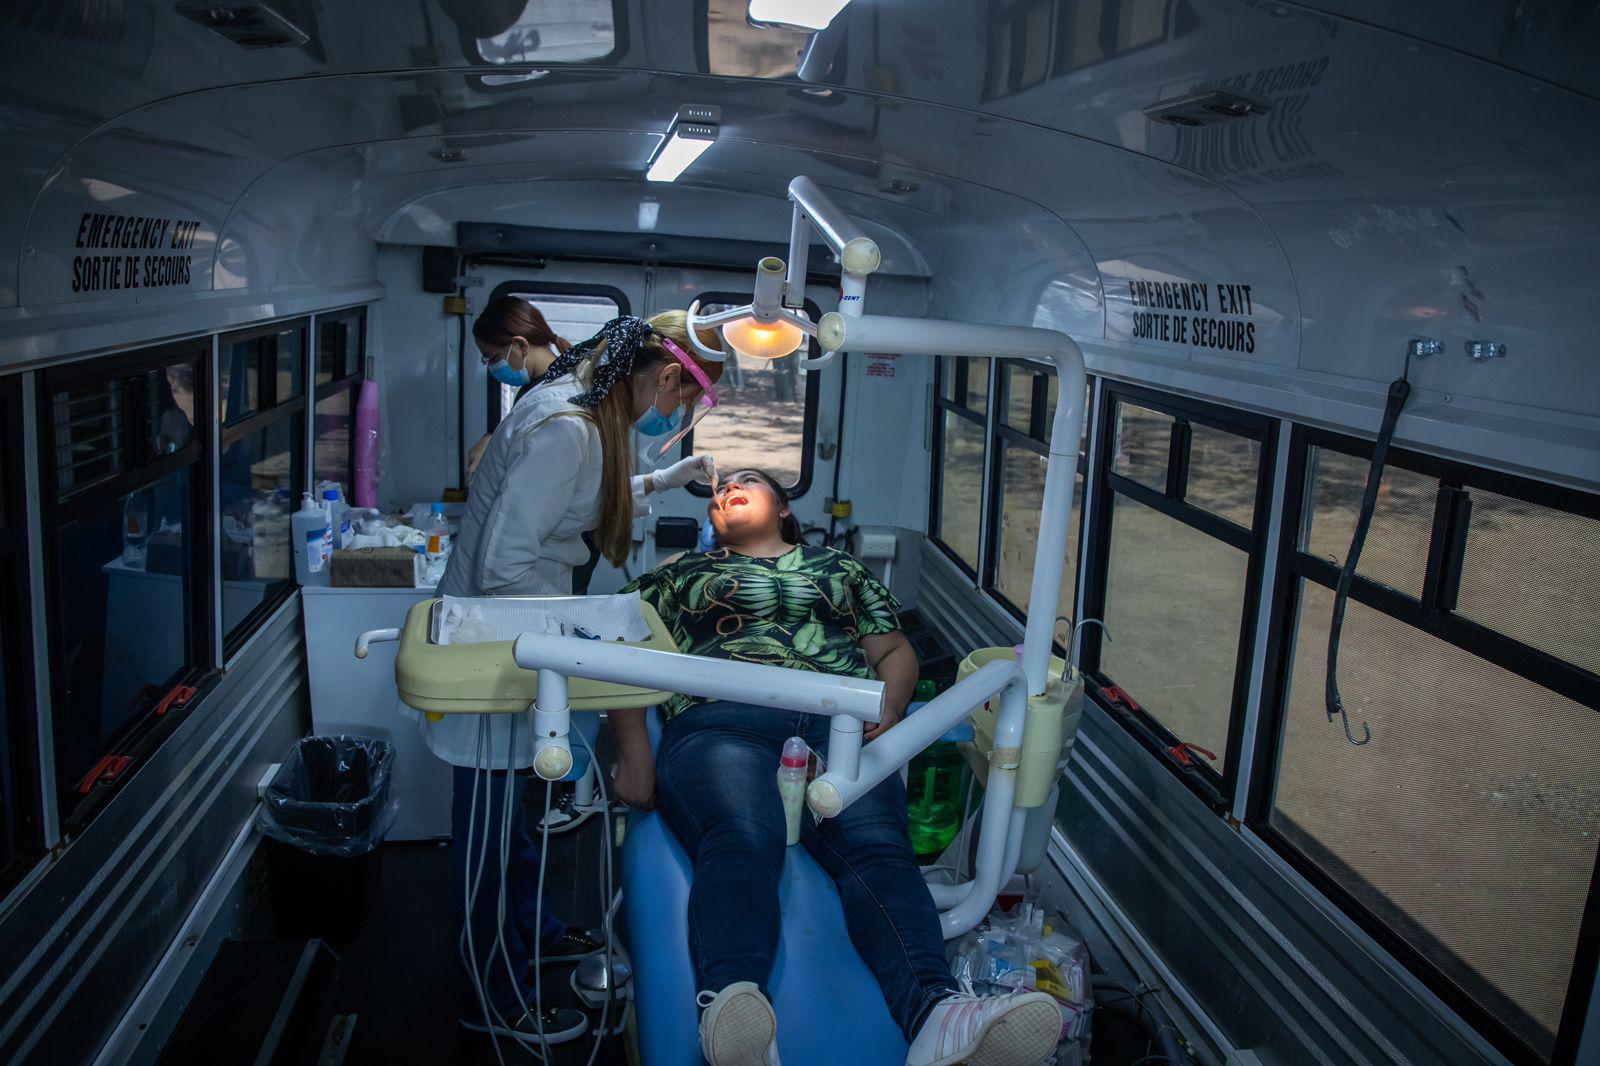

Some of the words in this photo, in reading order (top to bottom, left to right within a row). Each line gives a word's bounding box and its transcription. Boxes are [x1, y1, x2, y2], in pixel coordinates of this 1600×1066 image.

[76, 212, 170, 249] EMERGENCY
[171, 220, 201, 249] EXIT
[72, 255, 122, 292] SORTIE
[124, 256, 140, 289] DE
[143, 255, 192, 288] SECOURS
[1128, 280, 1209, 311] EMERGENCY
[1217, 284, 1252, 315] EXIT
[1133, 311, 1170, 342] SORTIE
[1173, 315, 1187, 344] DE
[1192, 317, 1255, 353] SECOURS
